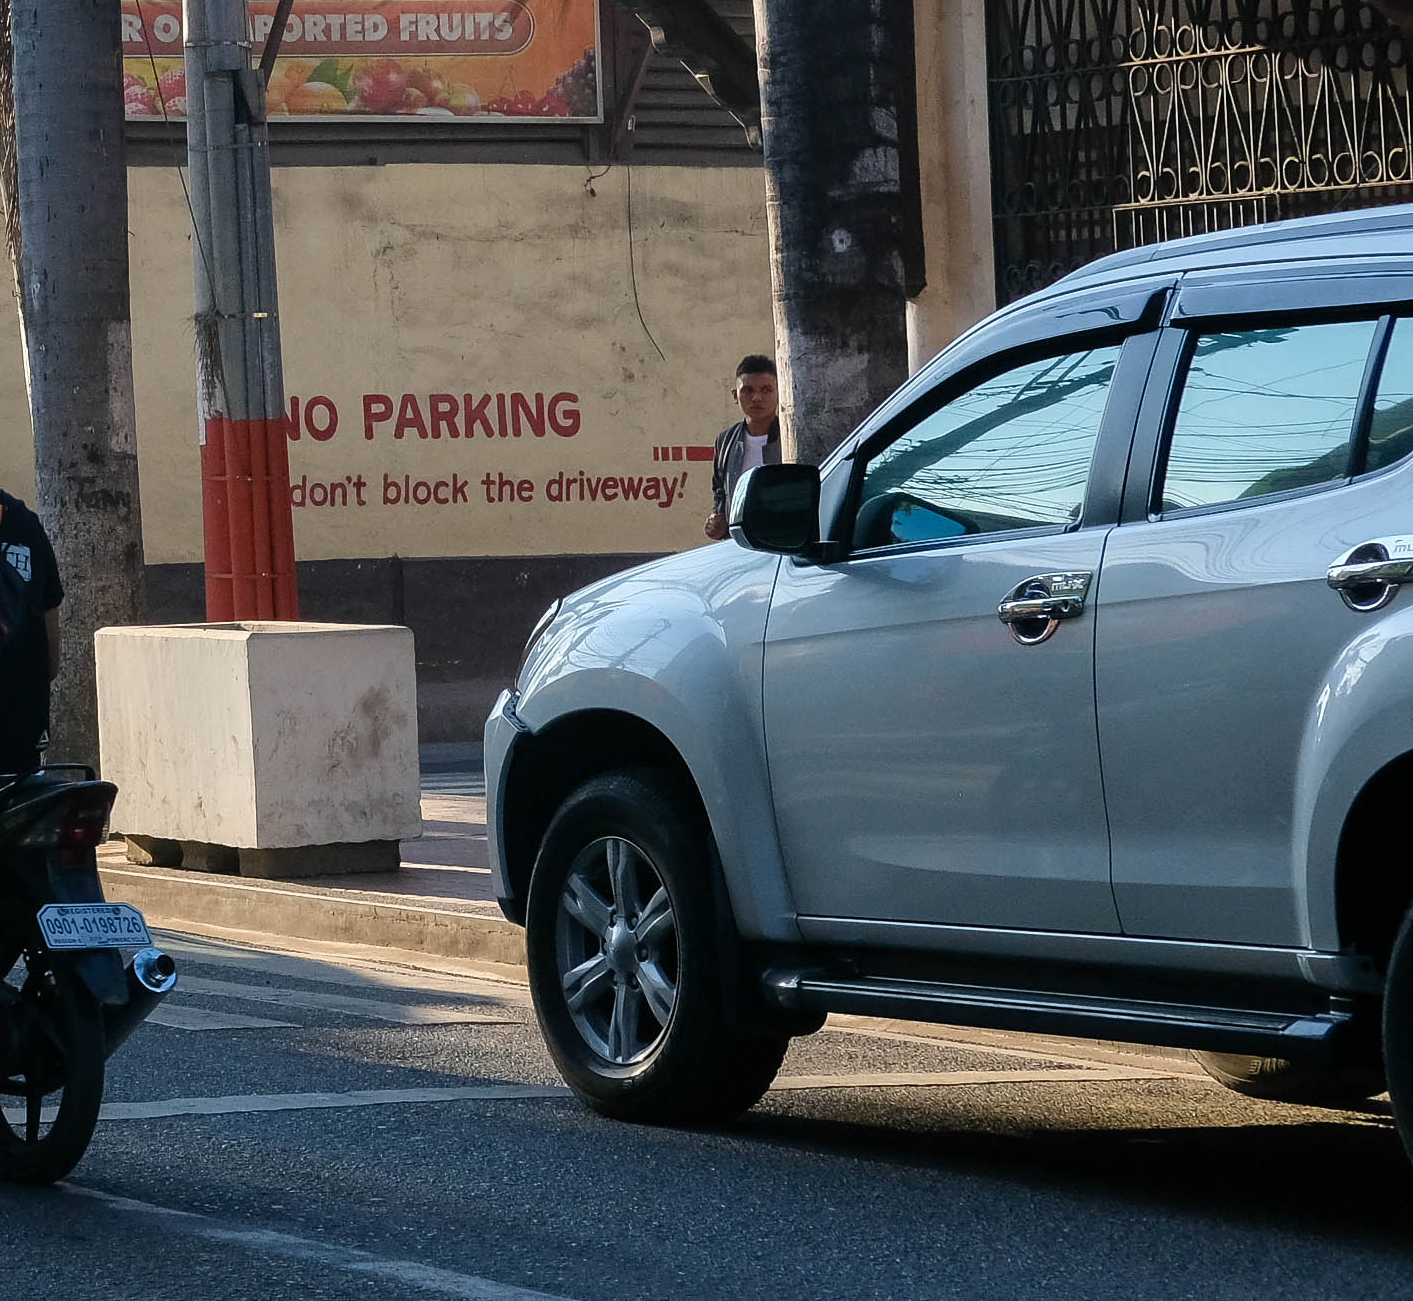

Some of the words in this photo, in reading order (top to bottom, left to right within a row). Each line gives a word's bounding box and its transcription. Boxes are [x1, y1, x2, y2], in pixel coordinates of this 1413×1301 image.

[398, 11, 513, 42] FRUITS
[284, 395, 339, 441] NO
[363, 392, 581, 440] PARKING
[290, 473, 367, 507] don't
[383, 469, 469, 505] block
[481, 470, 534, 503] the
[545, 471, 688, 508] driveway!
[45, 916, 142, 935] 0901-0198726
